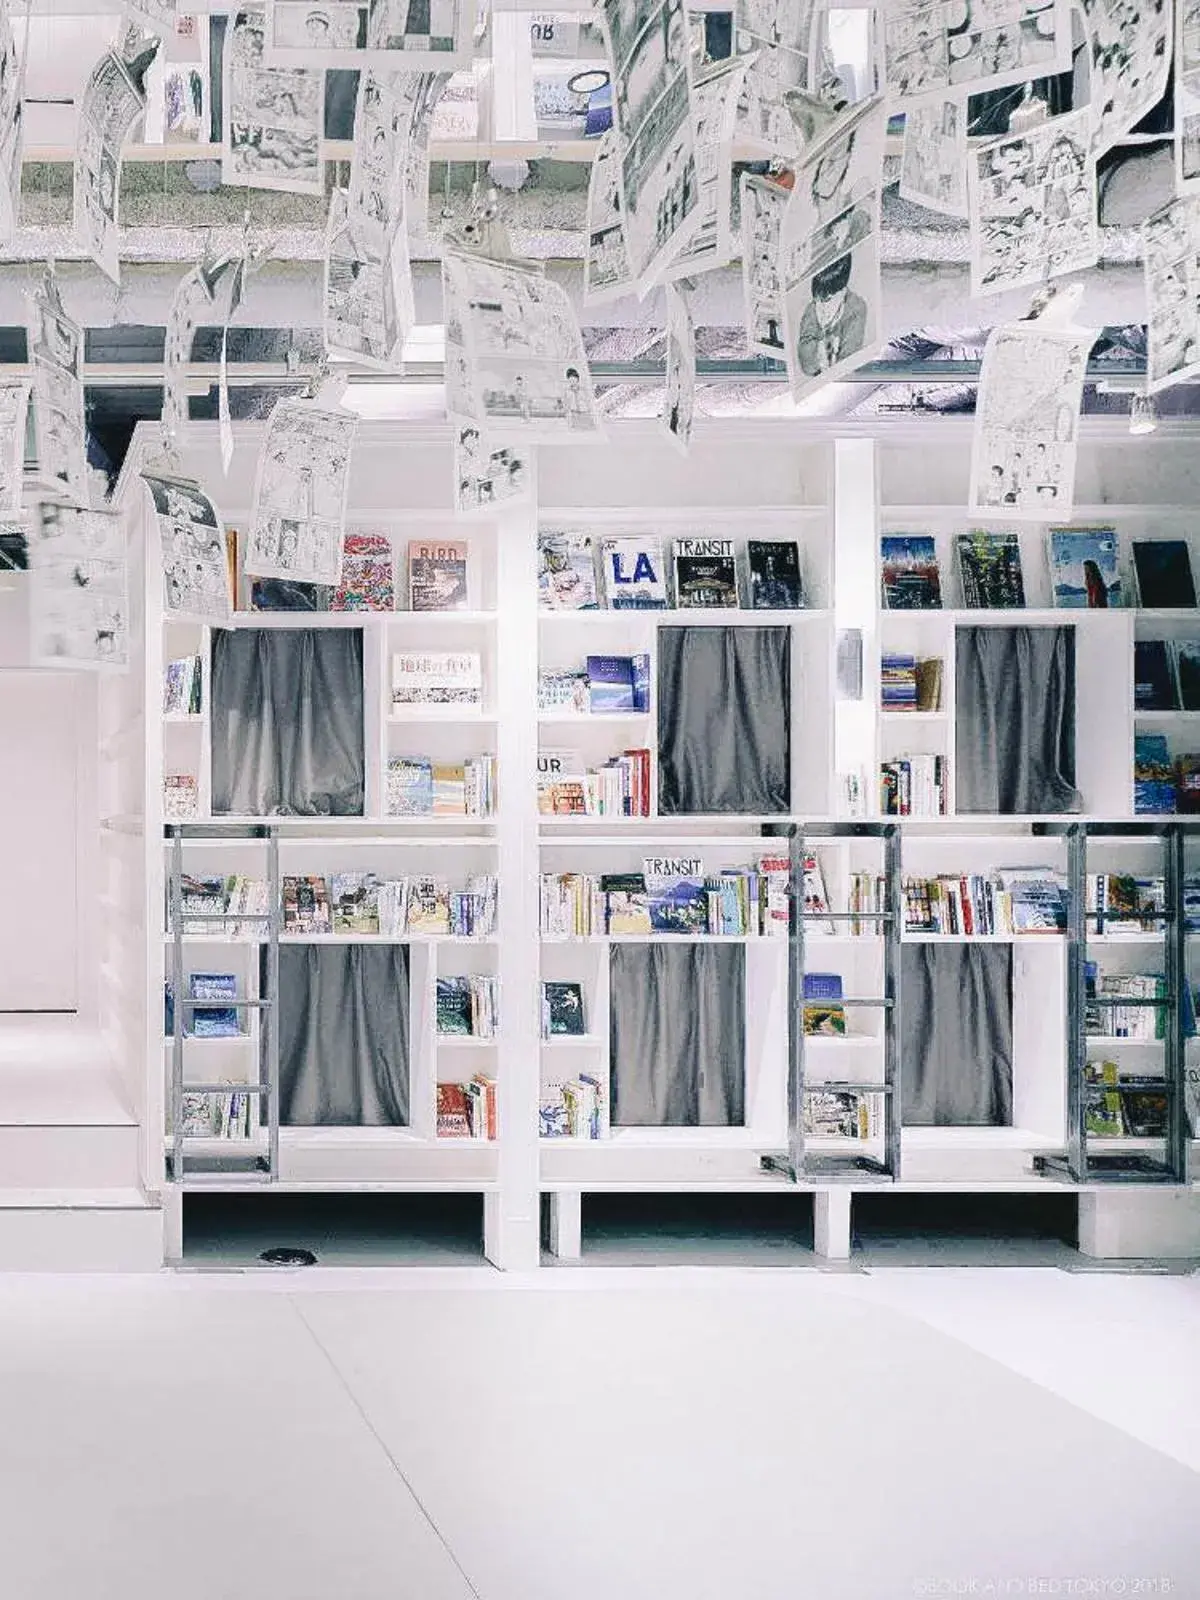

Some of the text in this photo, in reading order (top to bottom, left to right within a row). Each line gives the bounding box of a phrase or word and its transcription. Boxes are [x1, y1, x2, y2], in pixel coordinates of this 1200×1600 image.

[678, 539, 733, 556] TRANSIT
[612, 552, 657, 583] LA
[645, 858, 701, 875] TRANSIT
